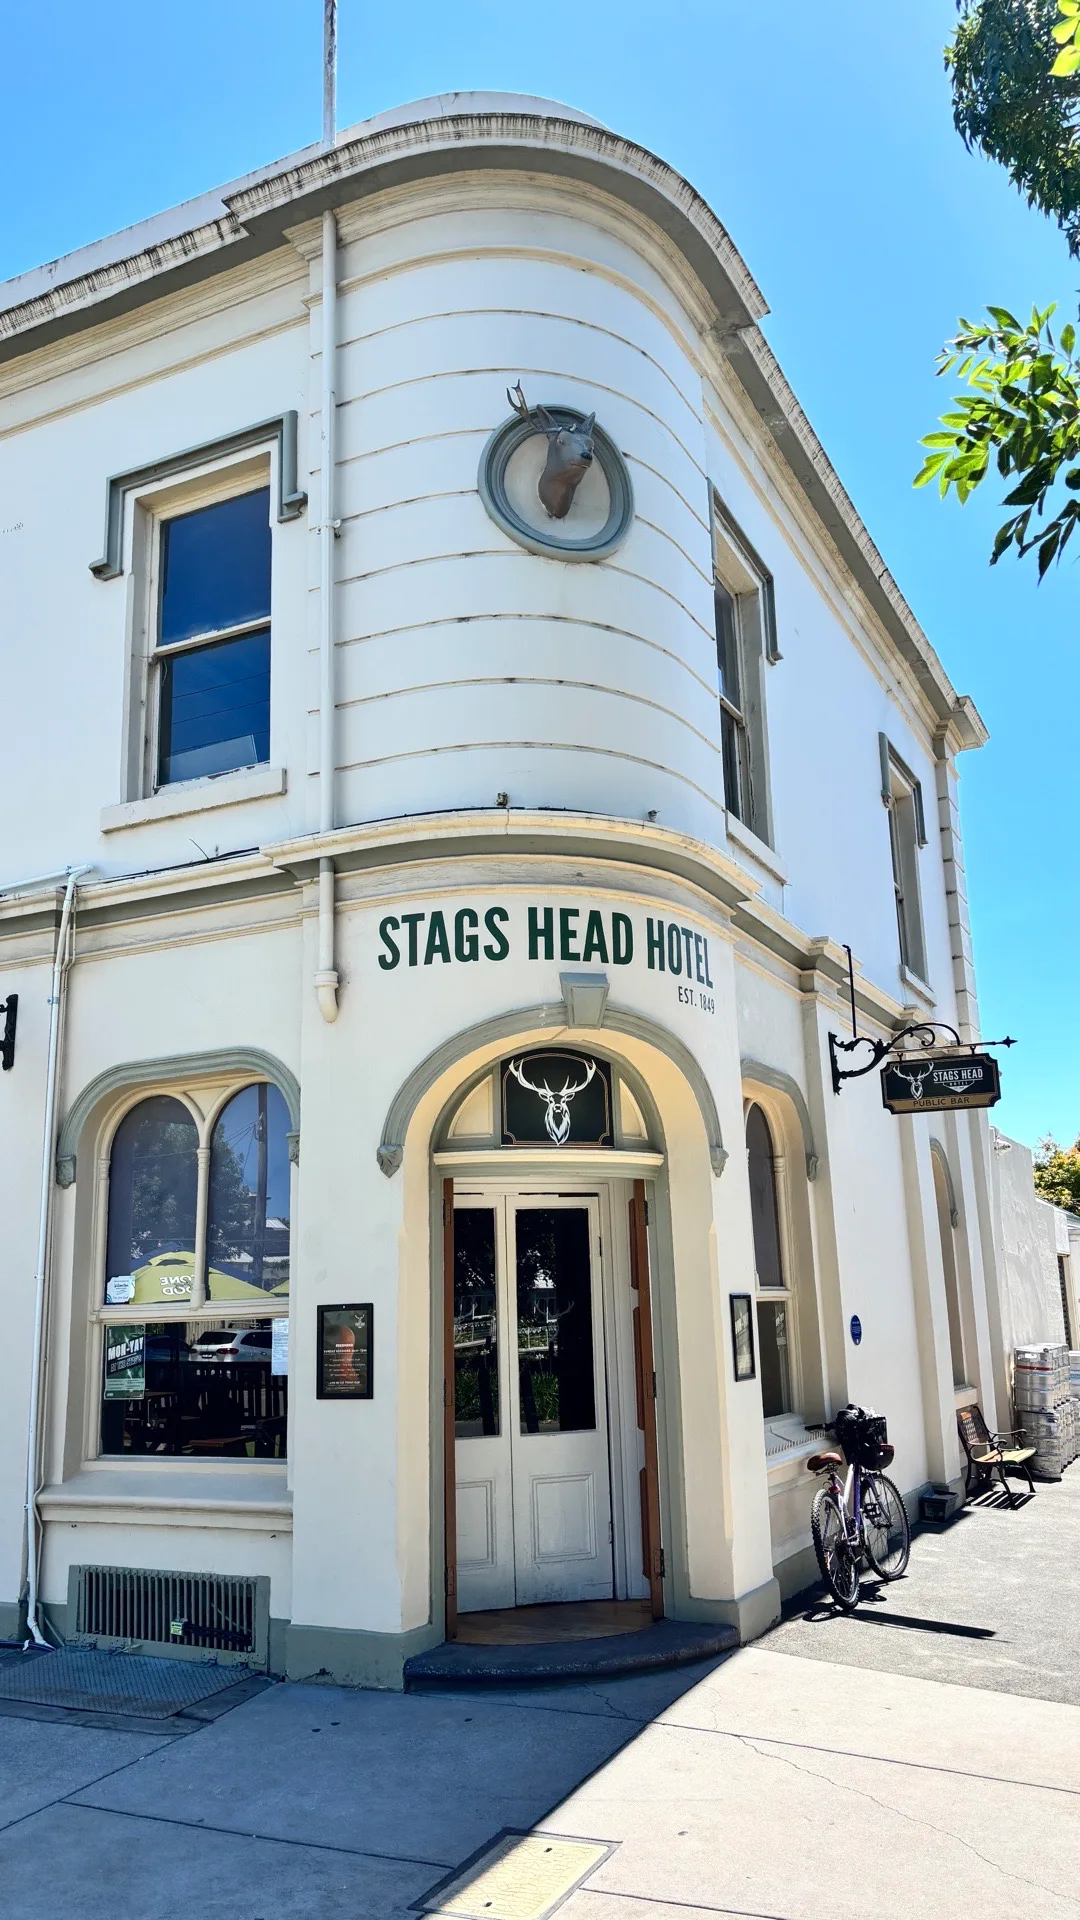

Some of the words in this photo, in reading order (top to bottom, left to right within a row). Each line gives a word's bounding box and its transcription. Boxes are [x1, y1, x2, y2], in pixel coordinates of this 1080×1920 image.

[378, 906, 510, 971] STAGS
[528, 906, 634, 966] HEAD
[646, 917, 714, 989] HOTEL
[678, 985, 698, 1007] EST.
[699, 992, 715, 1015] 1849
[933, 1070, 960, 1082] STAGS
[961, 1068, 983, 1080] HEAD
[913, 1098, 947, 1108] PUBLIC
[950, 1096, 970, 1105] BAR
